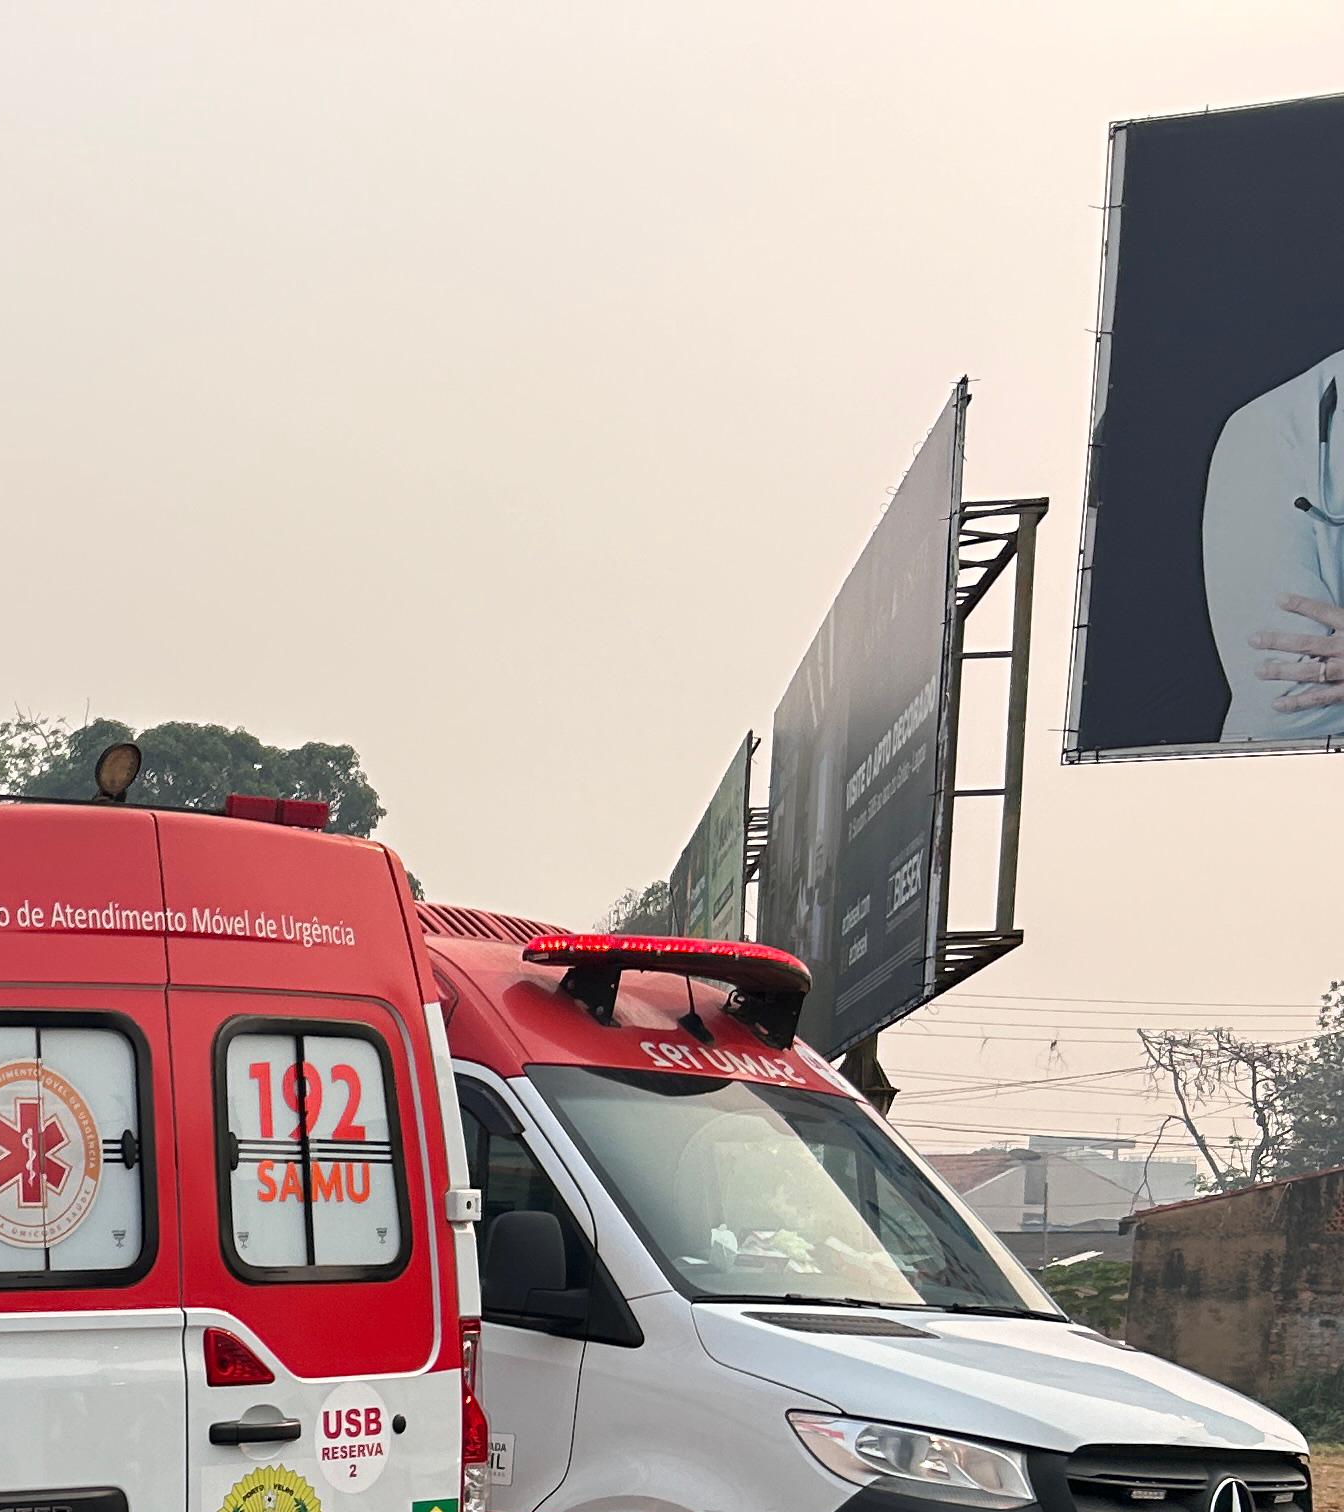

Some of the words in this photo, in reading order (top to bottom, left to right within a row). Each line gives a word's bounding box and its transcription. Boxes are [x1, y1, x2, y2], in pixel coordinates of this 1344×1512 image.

[17, 900, 44, 928] de
[51, 901, 187, 932] Atendimento
[192, 908, 250, 937] Móvel
[255, 912, 278, 938] de
[281, 914, 356, 947] Urgência
[249, 1062, 366, 1141] 192
[257, 1160, 370, 1204] SAMU
[323, 1407, 382, 1440] USB
[322, 1443, 383, 1461] RESERVA
[349, 1464, 357, 1478] 2
